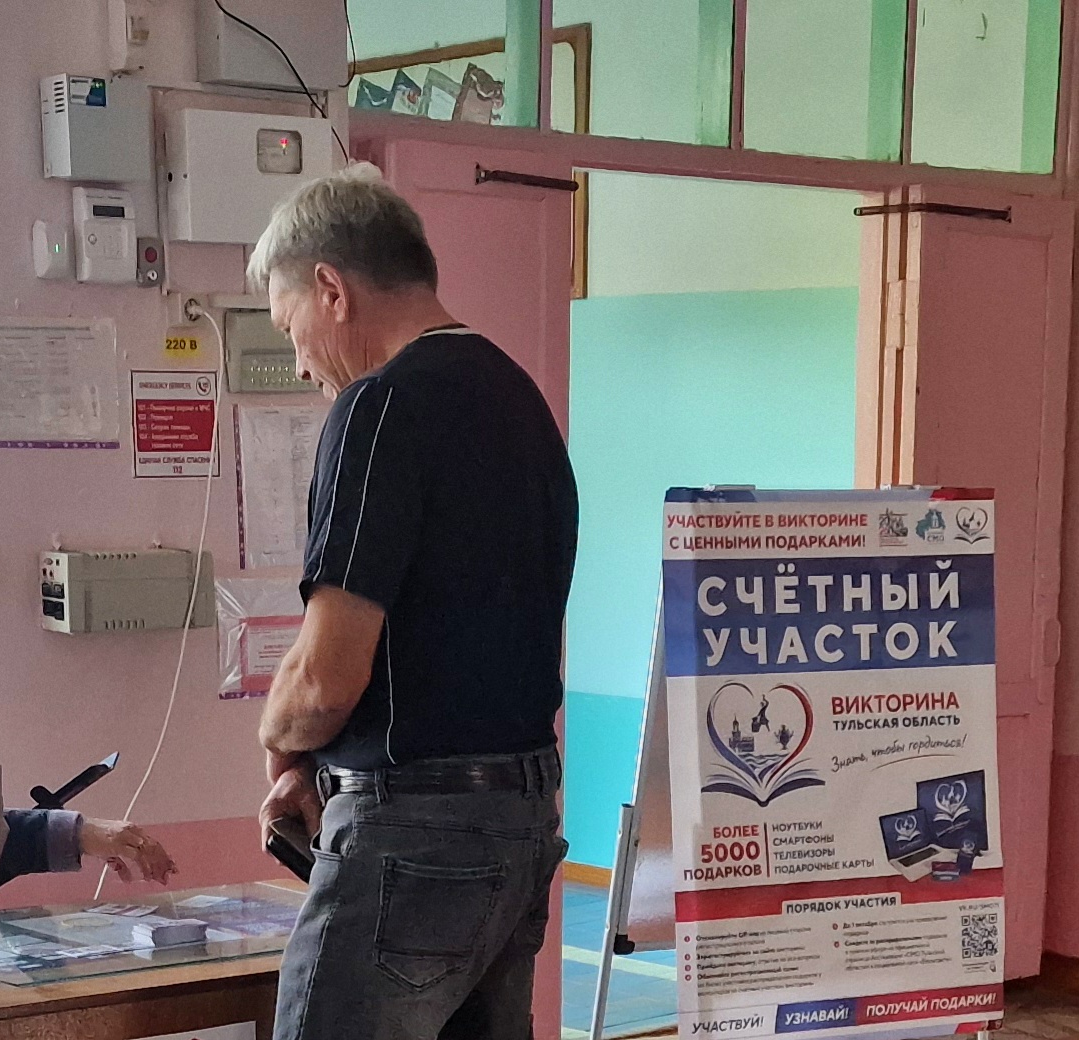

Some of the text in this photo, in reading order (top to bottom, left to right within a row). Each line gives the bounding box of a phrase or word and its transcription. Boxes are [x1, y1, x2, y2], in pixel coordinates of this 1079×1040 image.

[165, 339, 198, 350] 220 В
[667, 511, 868, 529] УЧАСТВУЙТЕ В ВИКТОРИНЕ
[669, 537, 680, 550] С
[683, 535, 761, 551] ЦЕННЫМИ
[765, 534, 866, 550] ПОДАРКАМИ!
[698, 559, 960, 616] СЧЁТНЫЙ
[702, 620, 958, 667] УЧАСТОК
[831, 691, 960, 715] ВИКТОРИНА
[833, 715, 961, 731] ТУЛЬСКАЯ ОБЛАСТЬ
[831, 733, 968, 773] Знать, чтобы гордиться!
[713, 824, 760, 839] БОЛЕЕ
[772, 821, 823, 832] НОУТБУКИ
[772, 834, 835, 847] СМАРТФОНЫ
[701, 840, 761, 864] 5000
[773, 848, 836, 861] ТЕЛЕВИЗОРЫ
[684, 864, 763, 881] ПОДАРКОВ
[774, 858, 875, 875] ПОДАРОЧНЫЕ КАРТЫ
[786, 896, 897, 915] ПОРЯДОК УЧАСТИЯ
[692, 992, 996, 1034] УЧАСТВУЙ! УЗНАВАЙ! ПОЛУЧАЙ ПОДАРКИ!
